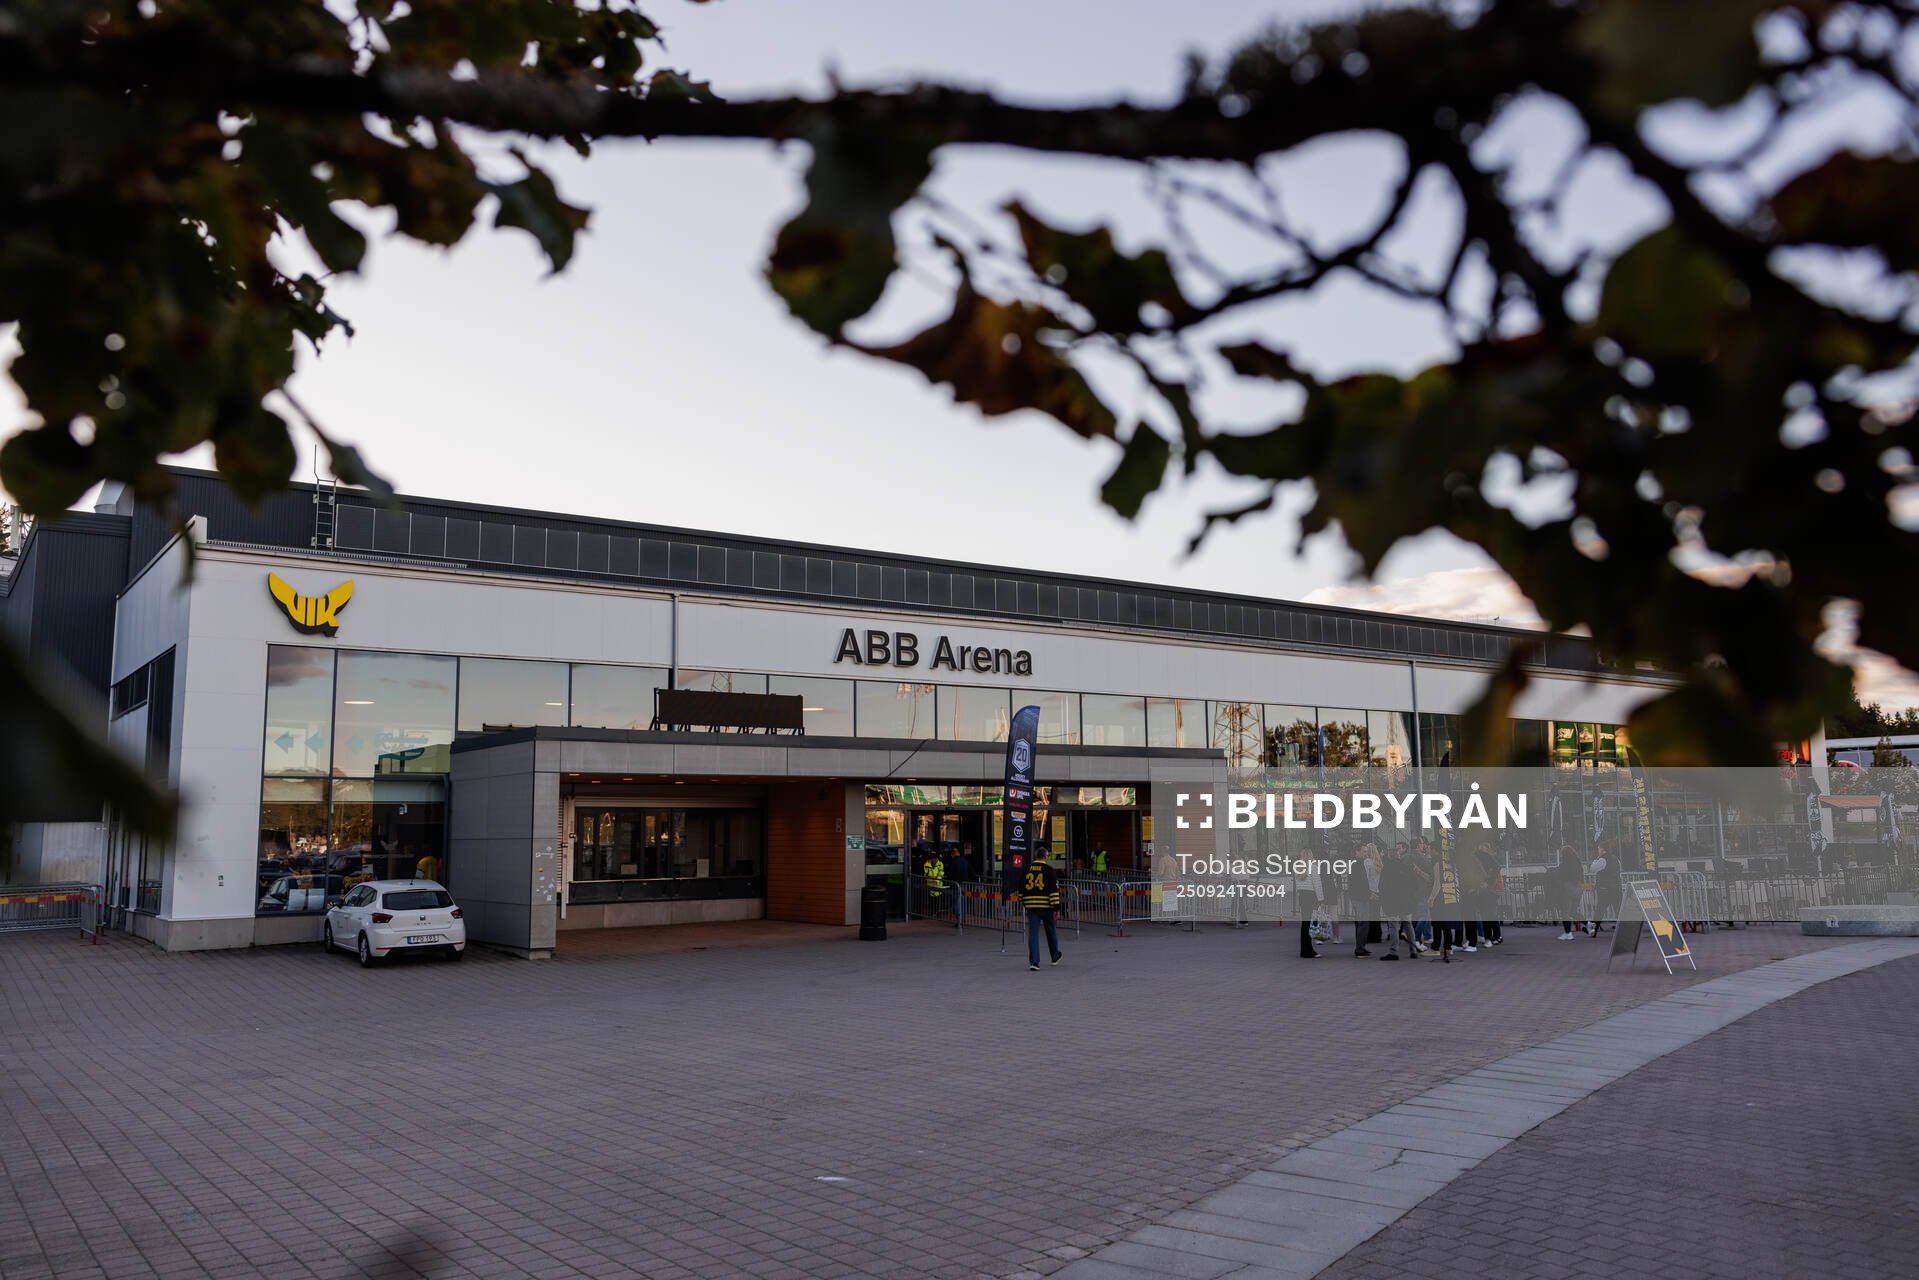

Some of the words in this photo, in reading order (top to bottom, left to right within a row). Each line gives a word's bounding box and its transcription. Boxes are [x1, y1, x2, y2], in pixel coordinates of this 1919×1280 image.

[834, 628, 920, 667] ABB
[930, 636, 1033, 676] Arena
[1015, 747, 1028, 762] 20
[1439, 818, 1457, 904] VÄSTERÅ
[1025, 873, 1045, 890] 34
